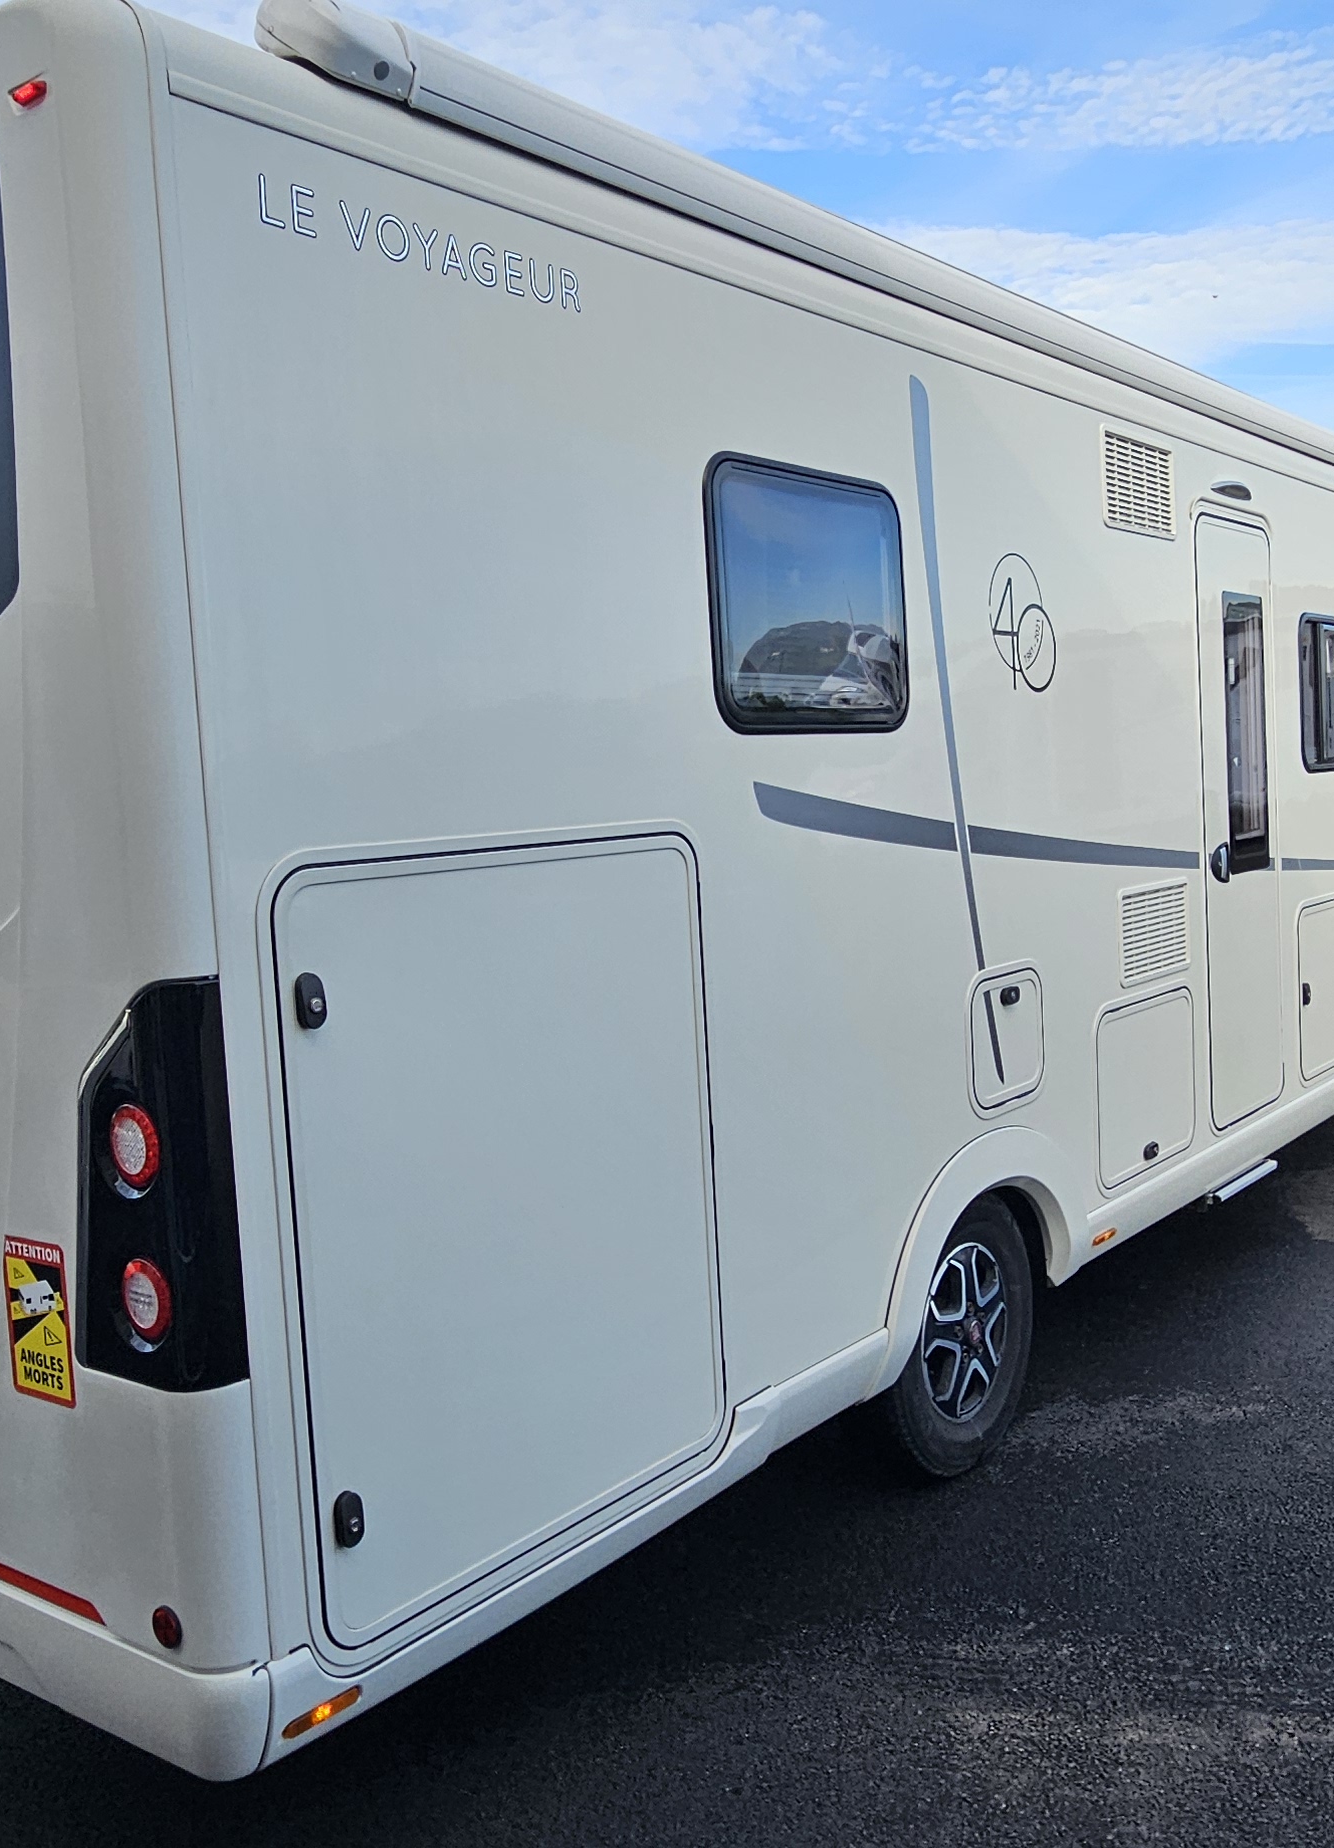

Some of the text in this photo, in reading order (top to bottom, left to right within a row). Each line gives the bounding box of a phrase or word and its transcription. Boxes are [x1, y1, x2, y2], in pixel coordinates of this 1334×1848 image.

[258, 173, 582, 312] LE VOYAGEUR
[5, 1240, 61, 1264] ATTENTION
[20, 1347, 65, 1374] ANGLES
[23, 1365, 64, 1390] MORTS
